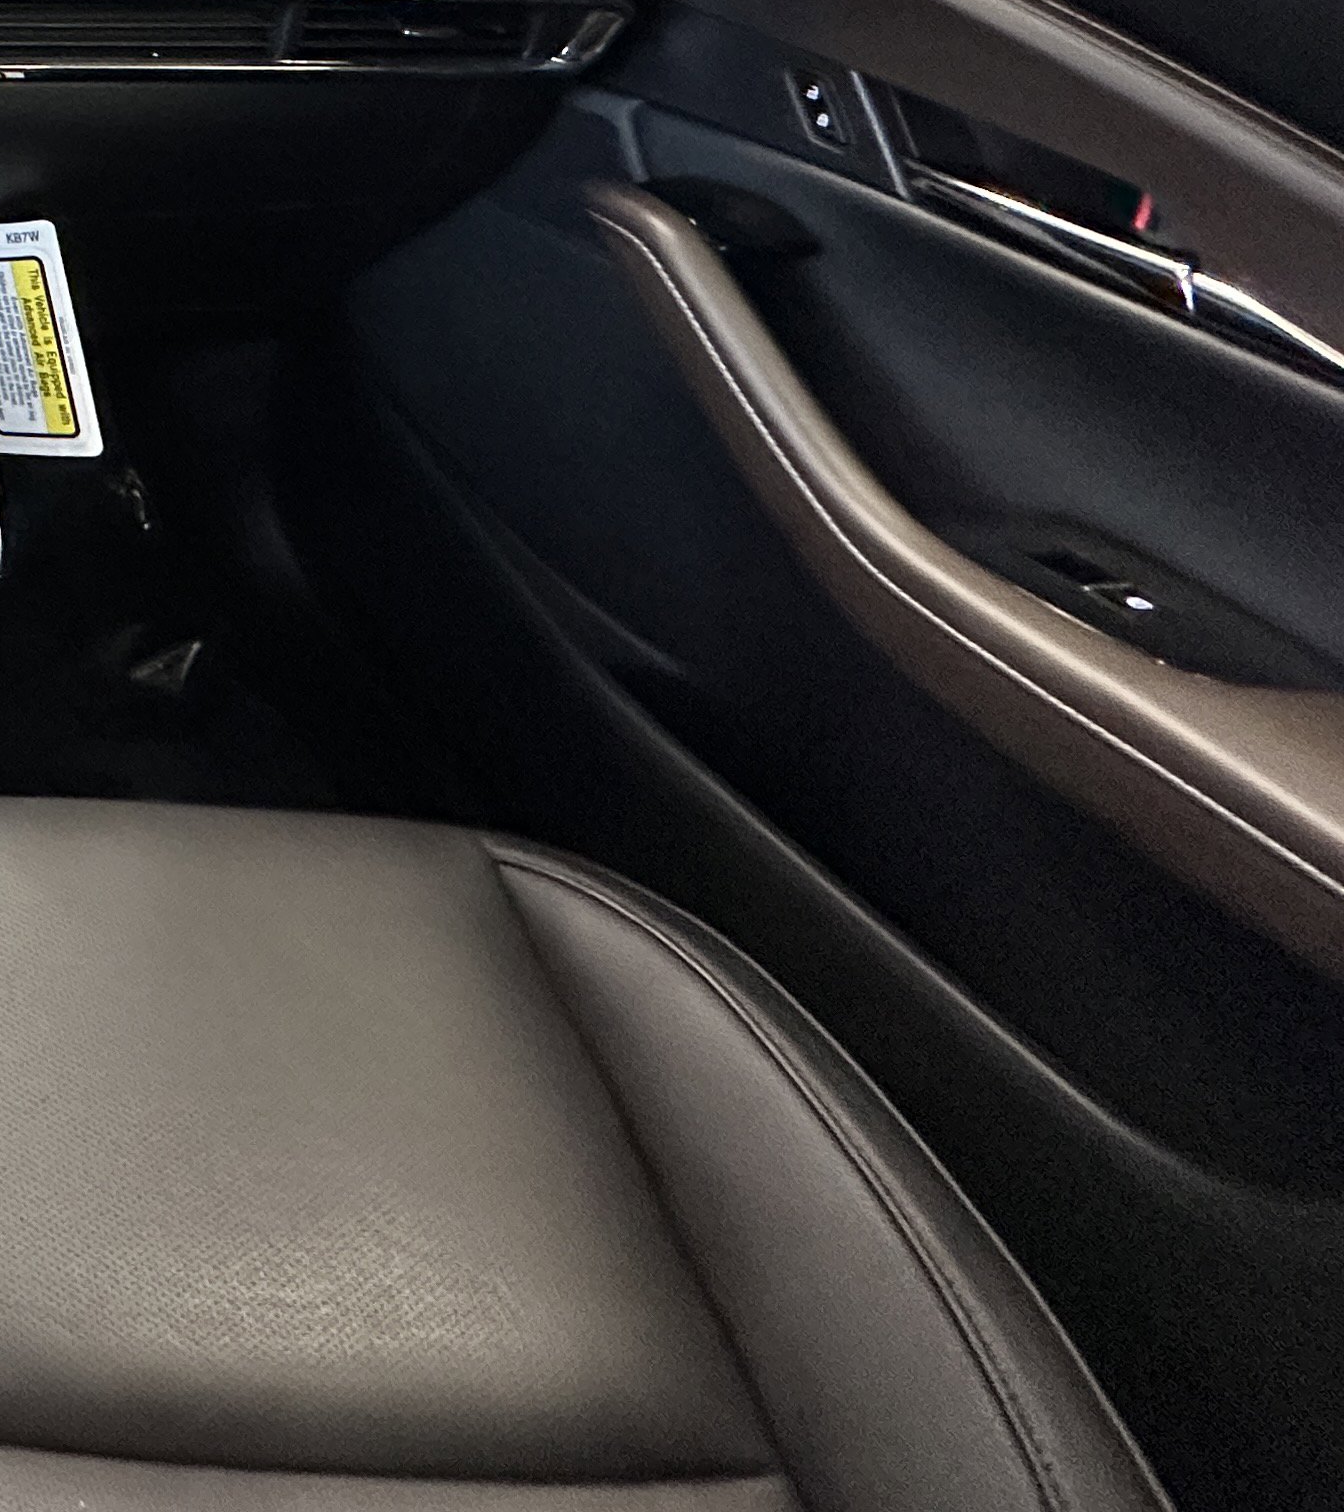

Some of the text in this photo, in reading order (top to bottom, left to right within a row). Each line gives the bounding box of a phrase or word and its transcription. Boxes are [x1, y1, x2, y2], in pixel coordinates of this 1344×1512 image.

[5, 230, 40, 244] KB7W
[21, 296, 52, 397] Advanced Air Bags
[27, 268, 72, 425] This Vehicle is Equipped with
